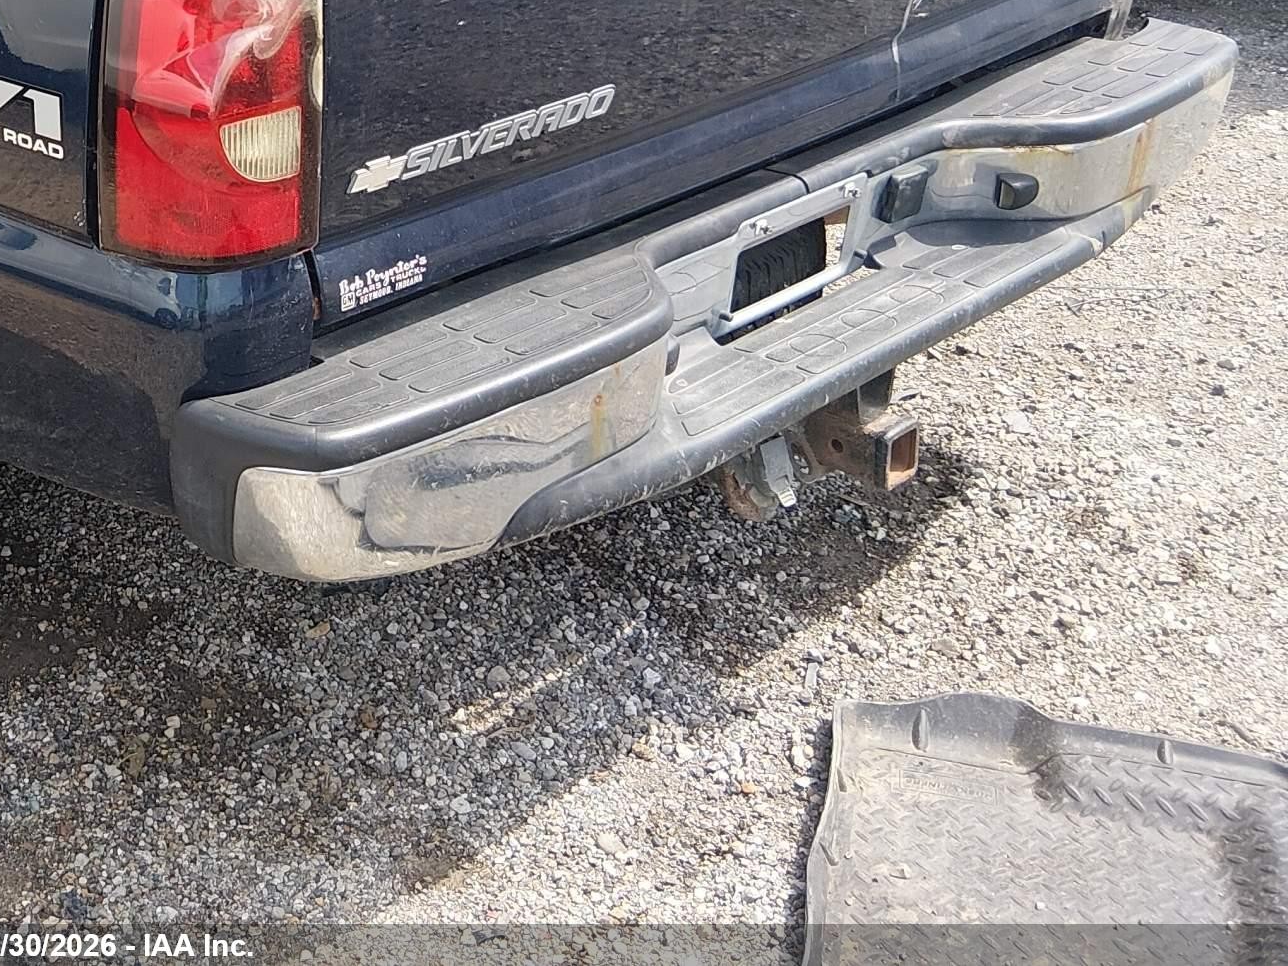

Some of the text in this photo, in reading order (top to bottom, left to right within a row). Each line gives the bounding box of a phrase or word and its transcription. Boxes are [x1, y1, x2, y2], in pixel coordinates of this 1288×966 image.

[3, 127, 64, 160] ROAD
[399, 84, 616, 181] SILVERADO
[339, 254, 427, 296] Bob Poynter's
[356, 282, 382, 297] CARS
